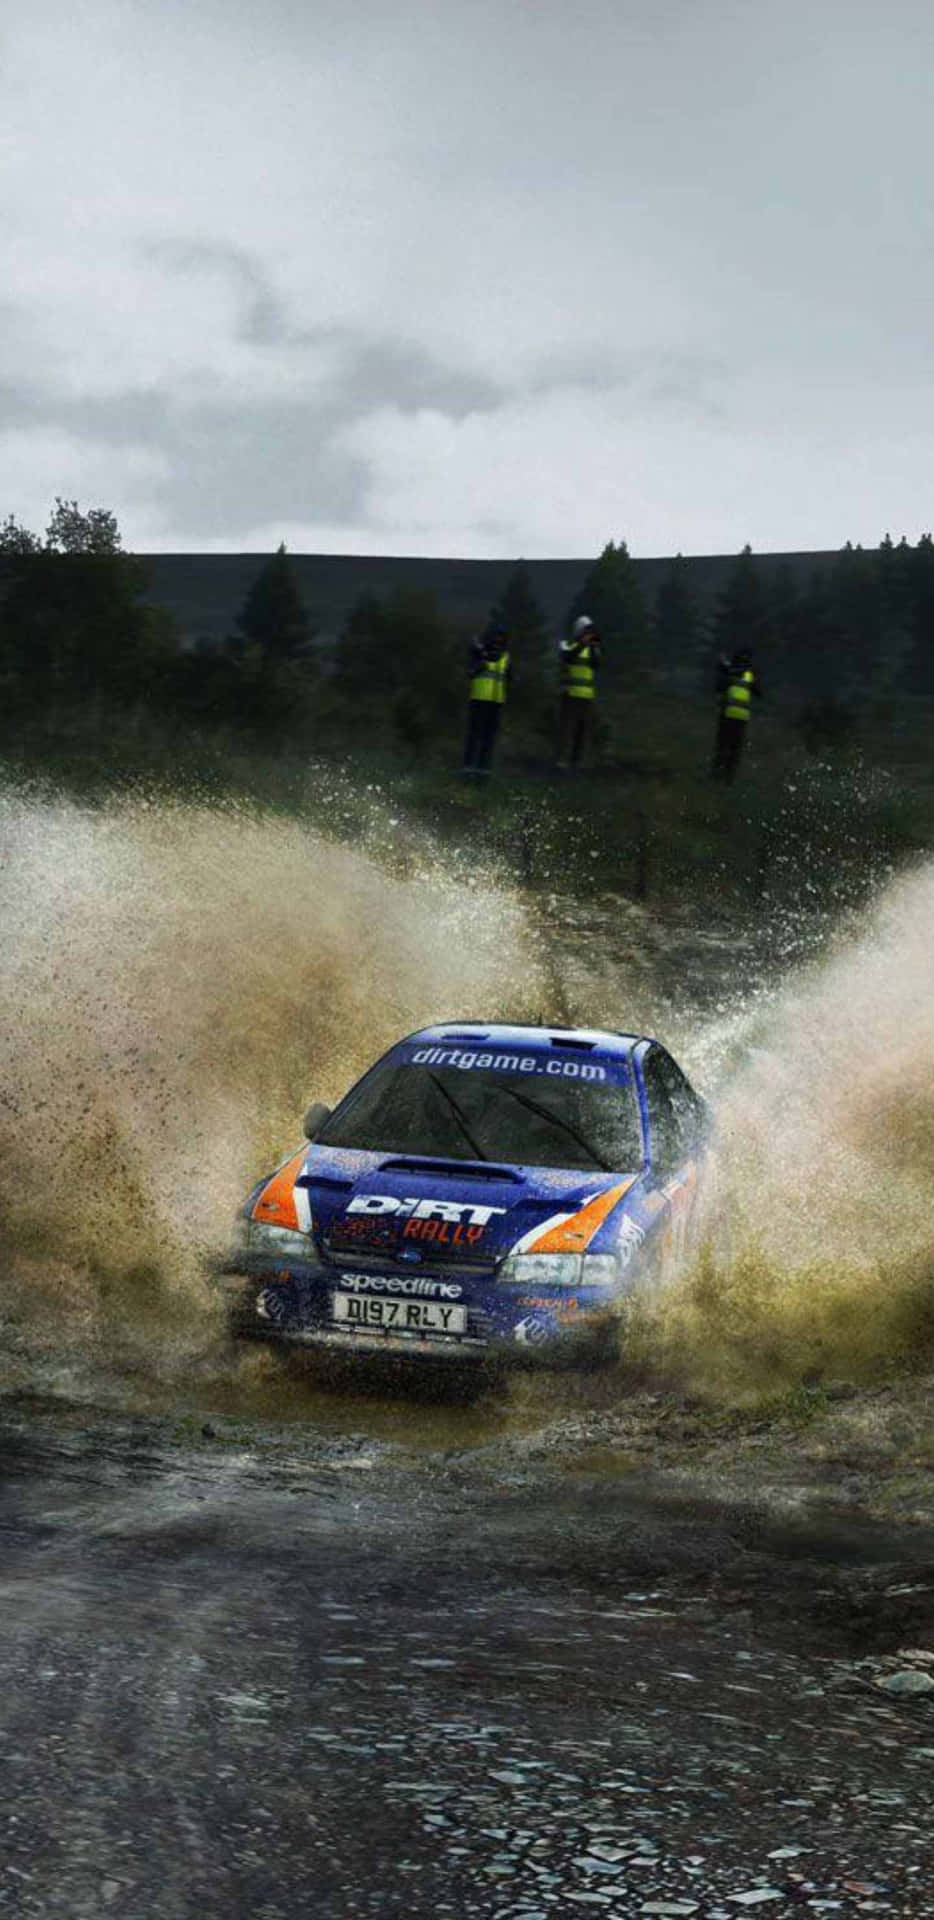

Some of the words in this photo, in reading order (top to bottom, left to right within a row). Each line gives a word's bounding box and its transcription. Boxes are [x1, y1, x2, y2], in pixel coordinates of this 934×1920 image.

[412, 1048, 606, 1081] dirtgame.com
[404, 1218, 484, 1244] RALLY
[340, 1273, 463, 1297] speedline
[405, 1307, 453, 1328] RLY
